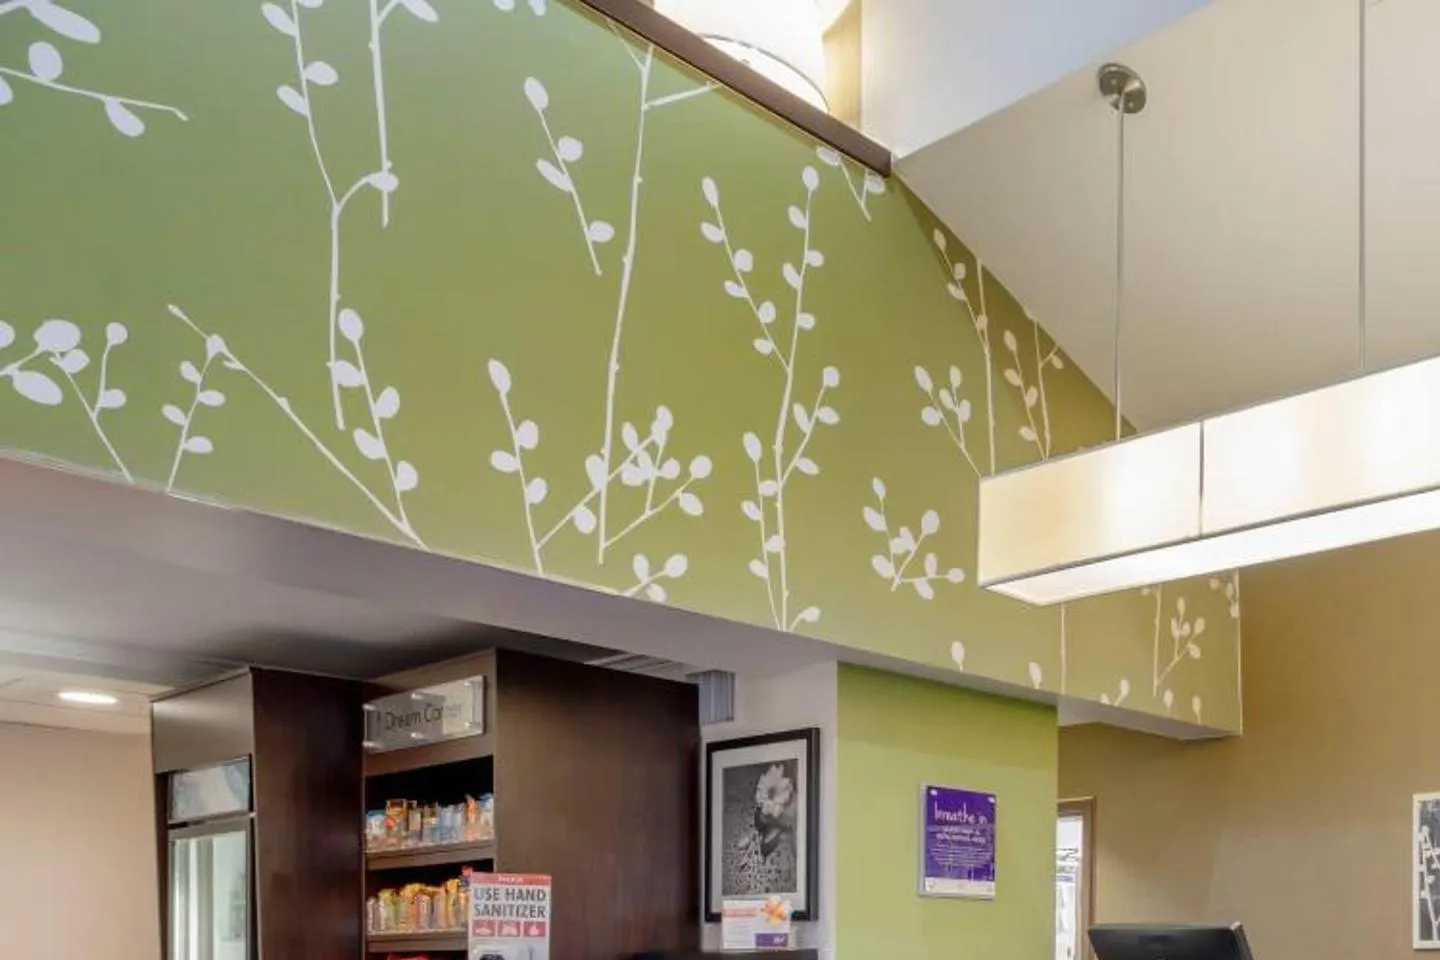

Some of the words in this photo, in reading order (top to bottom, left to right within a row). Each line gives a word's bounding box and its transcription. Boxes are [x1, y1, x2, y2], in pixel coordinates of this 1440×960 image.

[473, 887, 500, 902] USE
[505, 888, 547, 903] HAND
[473, 904, 547, 919] SANITIZER
